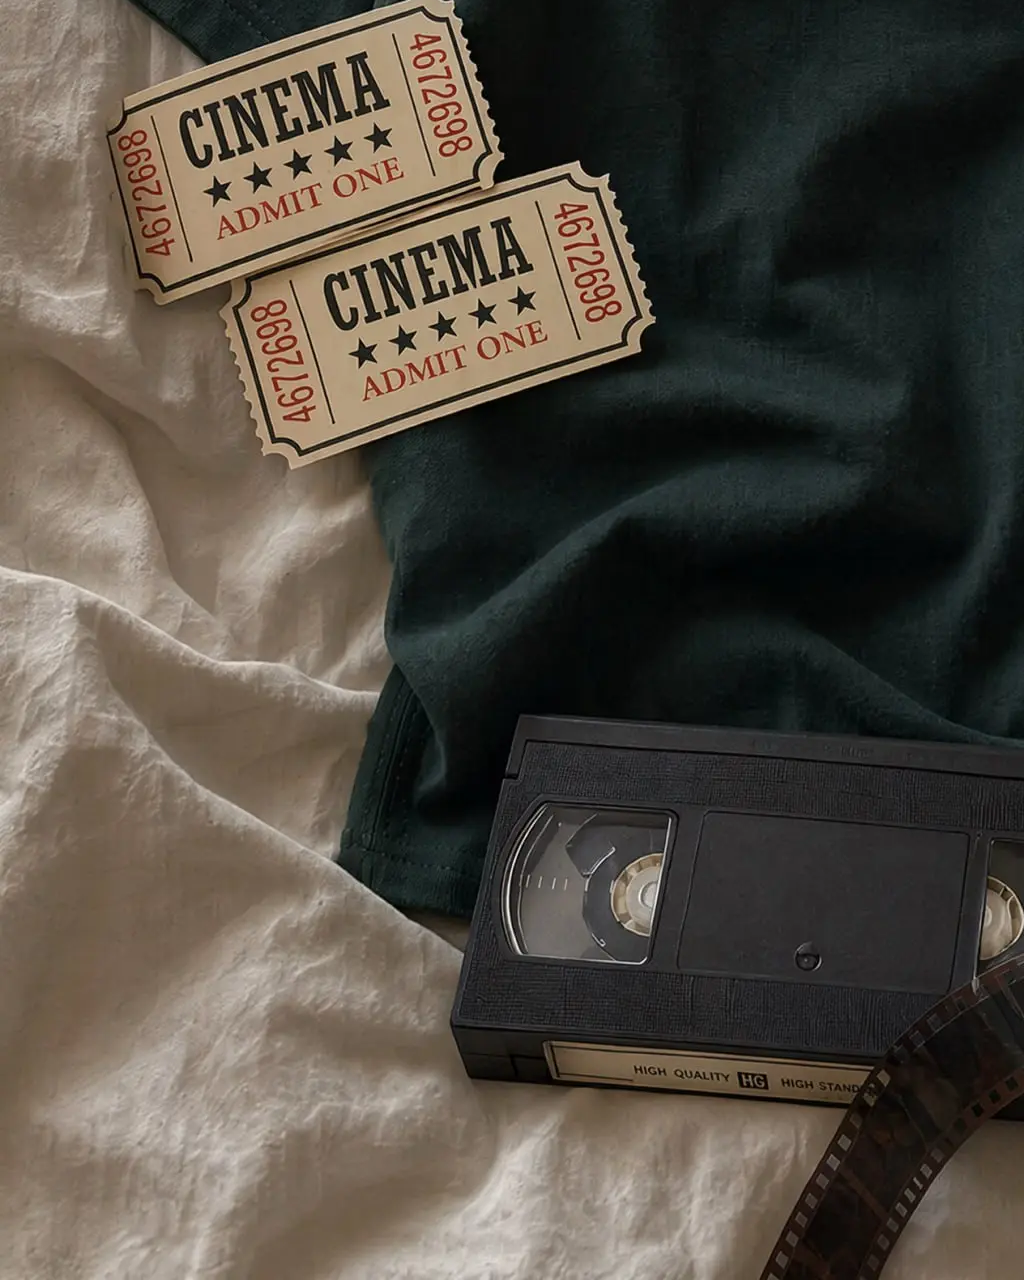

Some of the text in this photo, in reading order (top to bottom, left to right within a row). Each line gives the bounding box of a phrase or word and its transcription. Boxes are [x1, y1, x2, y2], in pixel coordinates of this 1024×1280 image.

[179, 51, 391, 169] CINEMA
[410, 32, 473, 158] 4672698
[117, 129, 176, 257] 4672698
[217, 156, 405, 240] ADMIT ONE
[323, 216, 534, 331] CINEMA
[554, 202, 623, 324] 4672698
[250, 298, 317, 424] 4672698
[361, 320, 549, 401] ADMIT ONE
[633, 1065, 861, 1094] HIGH QUALITY HG HIGH STAND
